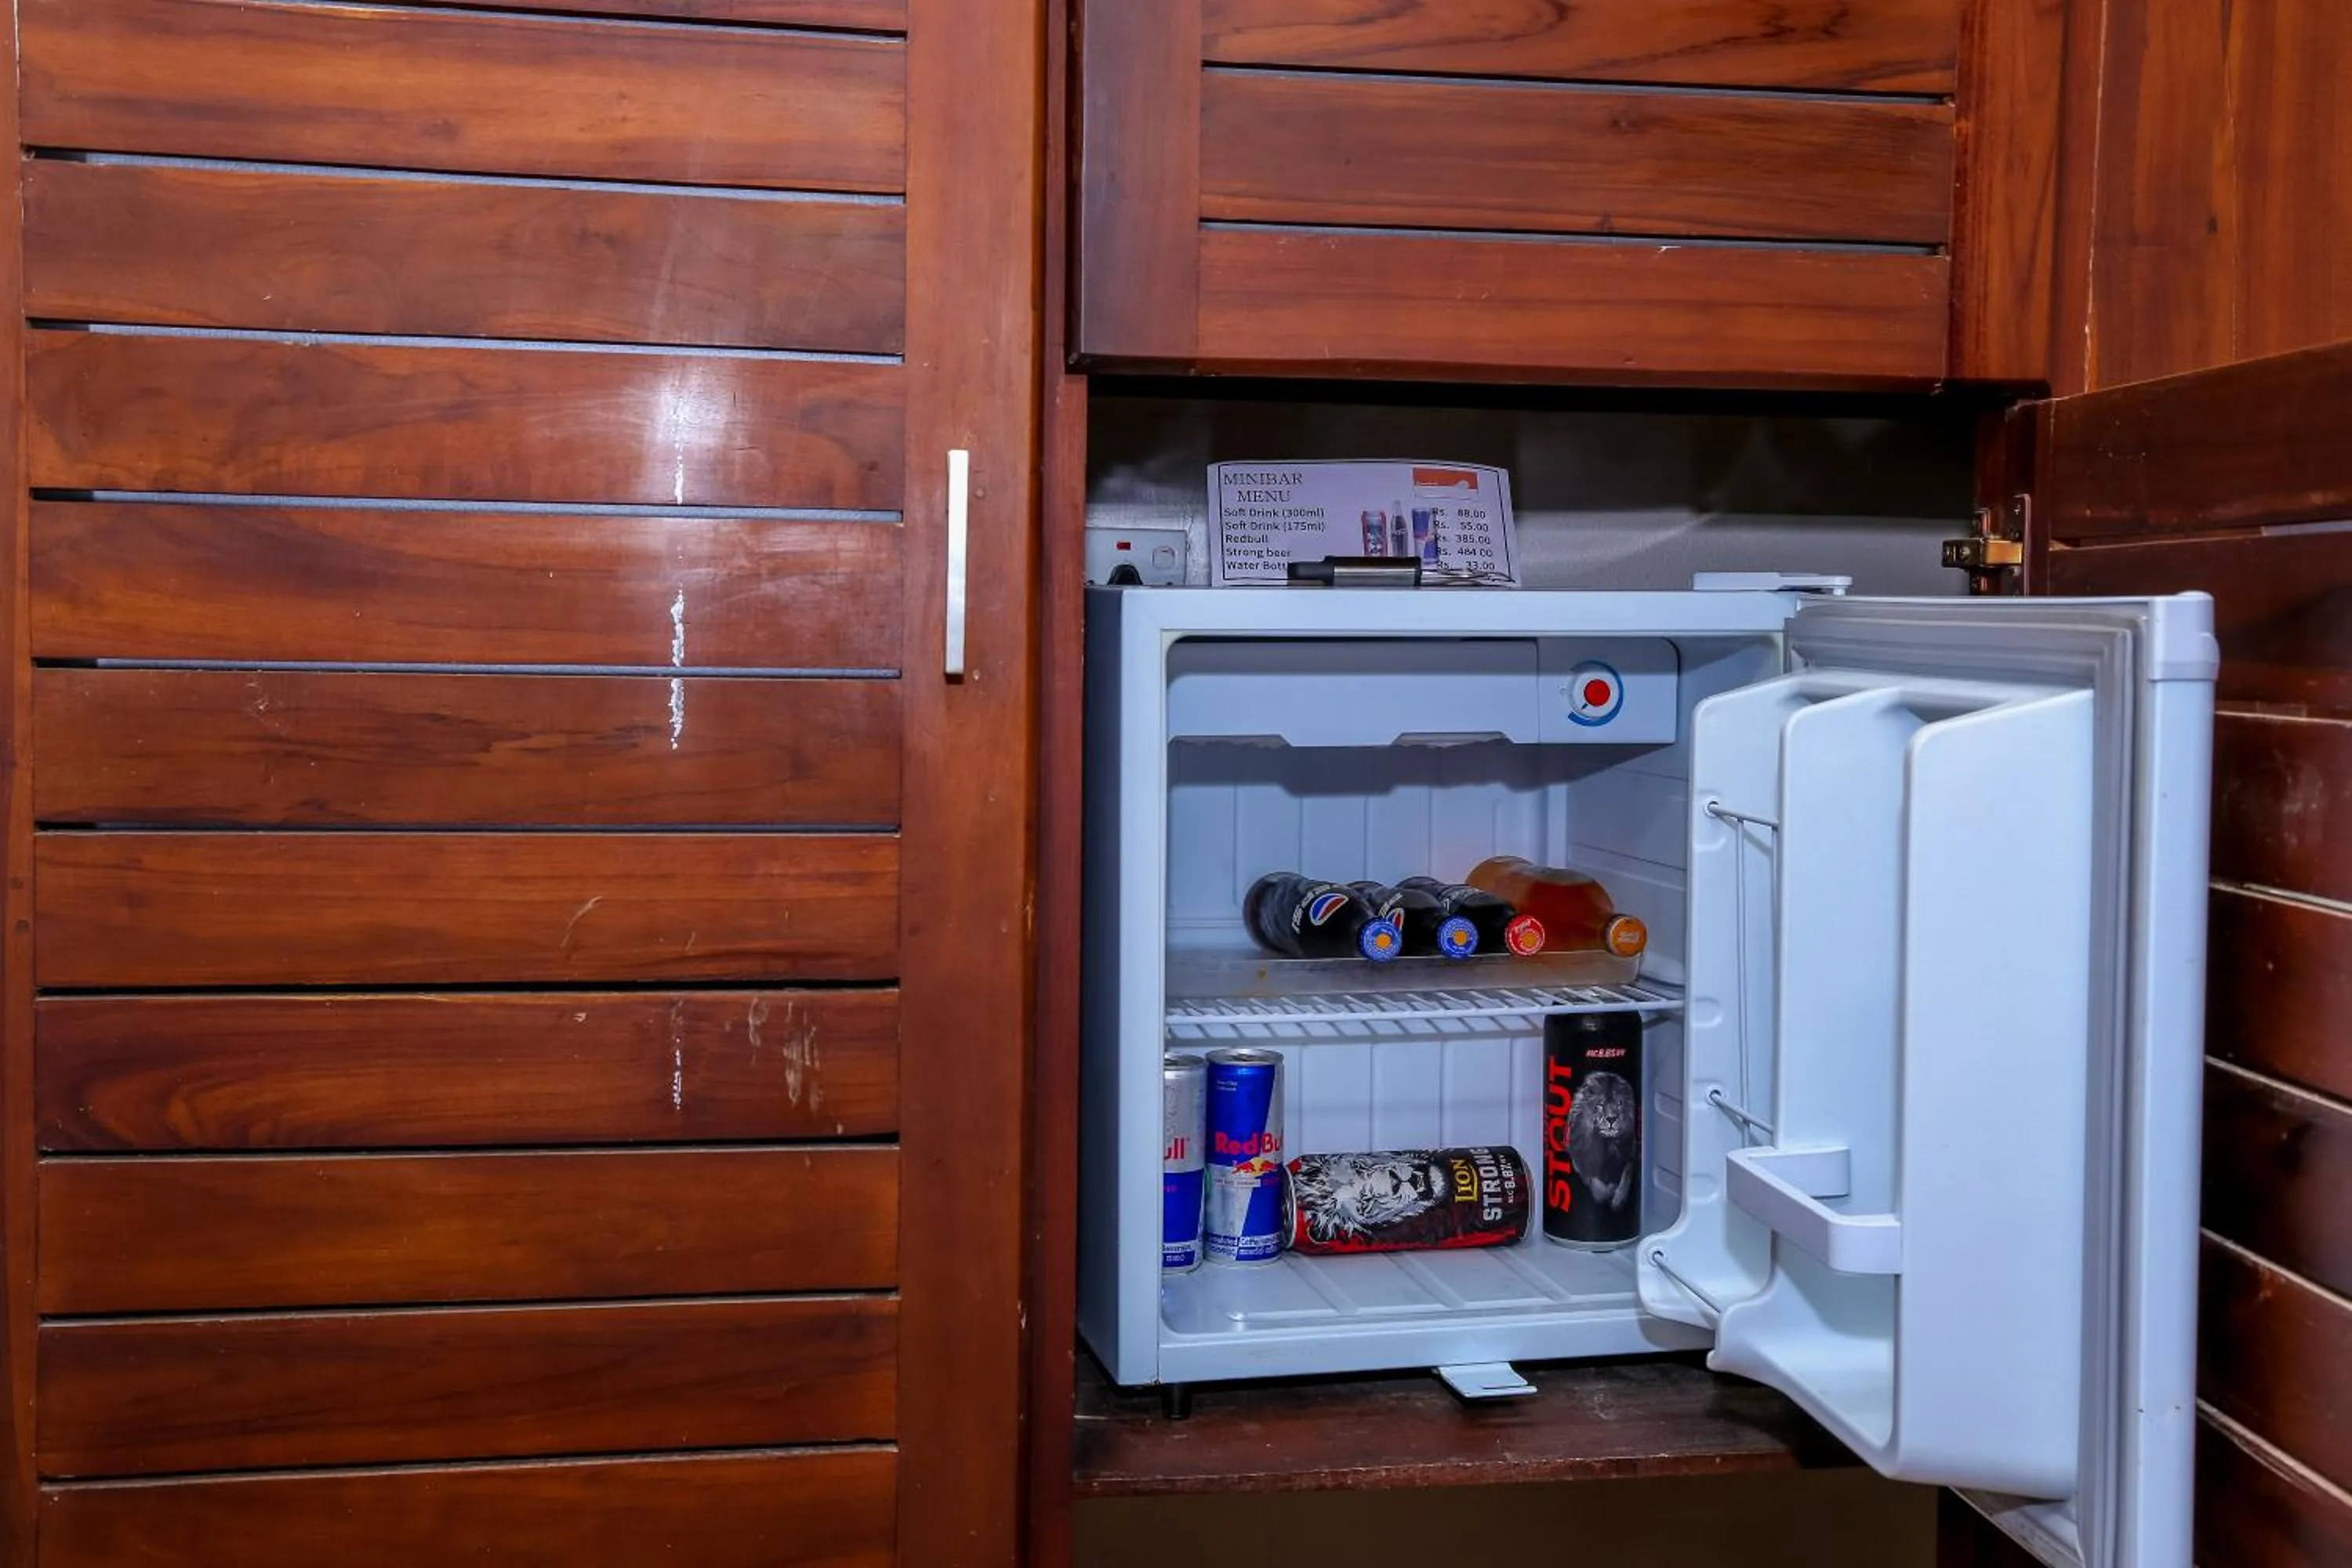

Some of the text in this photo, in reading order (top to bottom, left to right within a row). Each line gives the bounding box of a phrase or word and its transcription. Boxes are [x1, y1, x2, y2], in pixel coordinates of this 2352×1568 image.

[1223, 473, 1303, 485] MINIBAR
[1237, 490, 1290, 503] MENU
[1224, 508, 1246, 517] Soft
[1249, 508, 1279, 518] Drink
[1225, 521, 1326, 532] Soft Drink (175ml)
[1225, 535, 1269, 543] Redbull
[1225, 547, 1292, 558] Strong beer
[1458, 548, 1494, 557] 48400
[1226, 561, 1260, 570] Water
[1548, 1055, 1573, 1213] STOUT
[1215, 1131, 1259, 1155] Red
[1451, 1159, 1478, 1203] LION
[1470, 1148, 1503, 1221] STRONG
